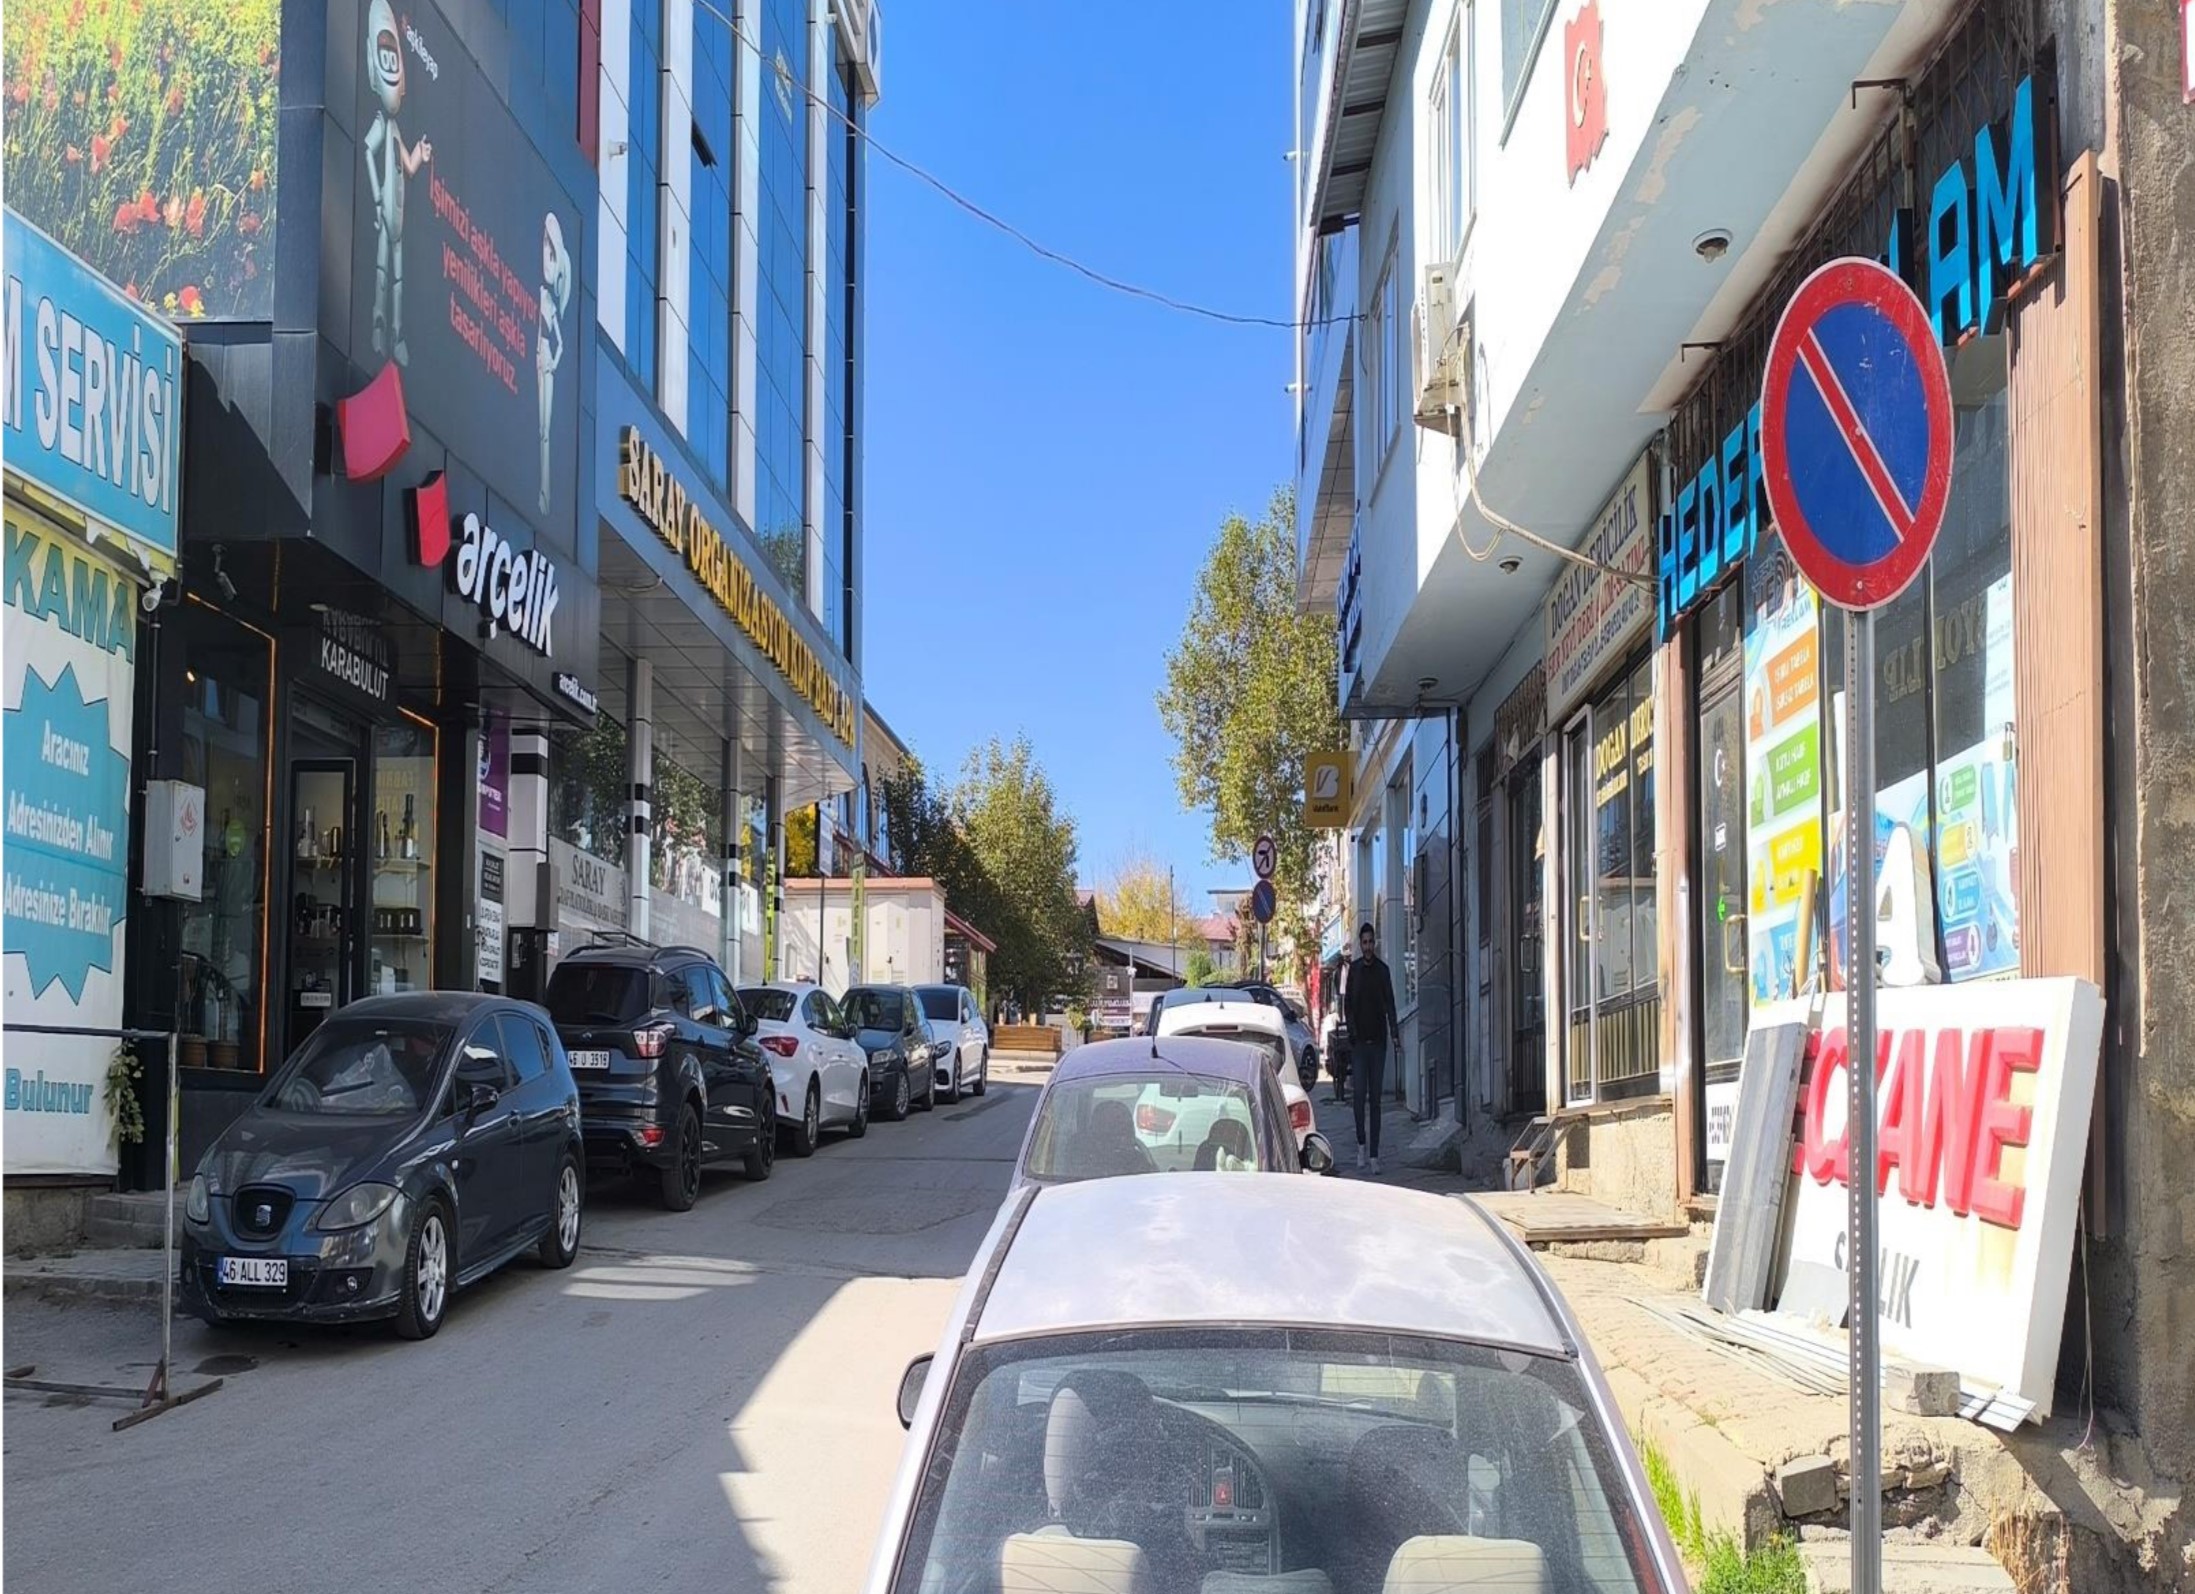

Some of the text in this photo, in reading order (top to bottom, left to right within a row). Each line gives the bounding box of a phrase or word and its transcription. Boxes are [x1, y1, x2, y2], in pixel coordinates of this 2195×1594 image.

[471, 225, 500, 278] aşkla
[499, 304, 526, 358] aşkla
[35, 296, 172, 514] SERVİSİ
[622, 424, 686, 556] SARAY
[457, 512, 559, 657] arçelik
[321, 637, 388, 701] KARABULUT
[41, 720, 90, 777] Aracınız
[8, 798, 114, 862] Adresinizden Alınır
[571, 853, 607, 897] SARAY
[3, 881, 113, 937] Adresinize Bırakılır
[4, 1067, 94, 1116] Bulunur
[223, 1260, 285, 1283] 46 ALL 329
[1834, 1230, 1920, 1329] SLIK
